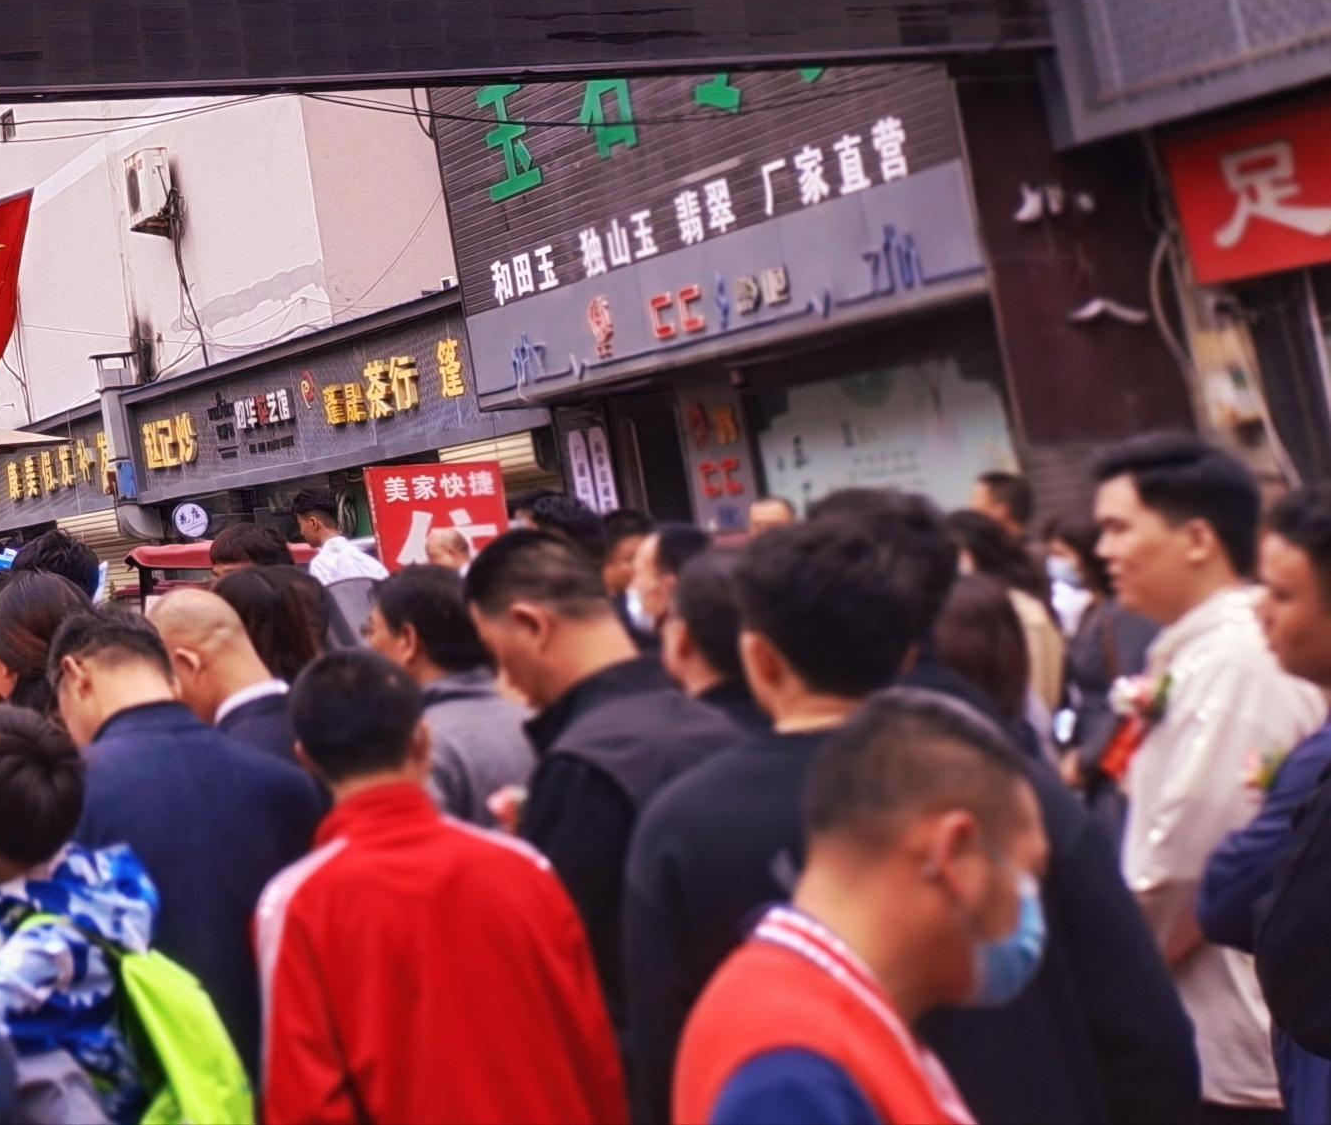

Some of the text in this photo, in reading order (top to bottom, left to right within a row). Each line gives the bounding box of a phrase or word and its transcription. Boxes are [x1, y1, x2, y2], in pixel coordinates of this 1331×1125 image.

[490, 116, 909, 307] 和田玉 独山玉 翡翠 厂家直营
[384, 470, 496, 504] 美家快捷
